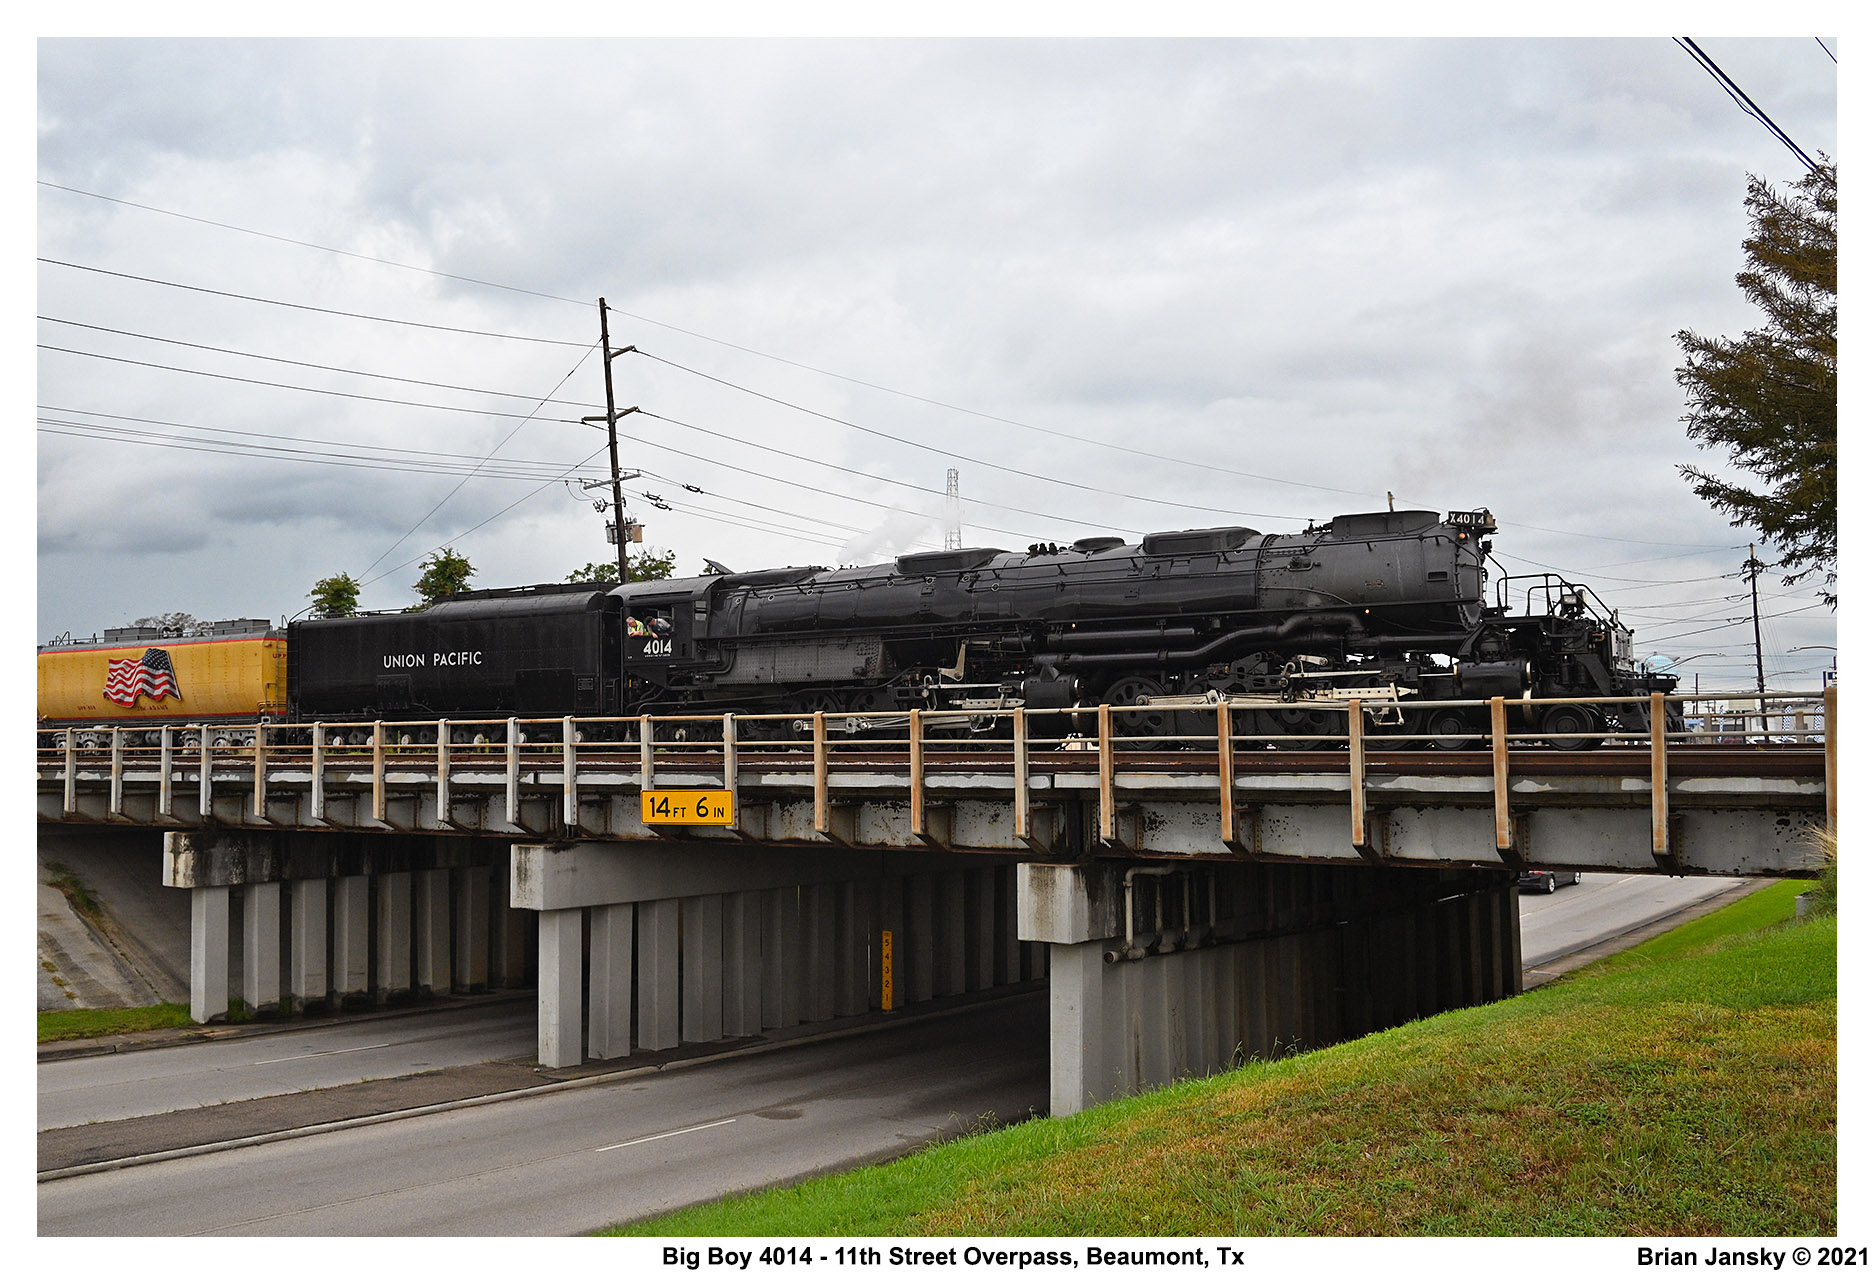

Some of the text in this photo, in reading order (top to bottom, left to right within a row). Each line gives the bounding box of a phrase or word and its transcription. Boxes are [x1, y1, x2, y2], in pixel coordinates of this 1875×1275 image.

[1450, 513, 1485, 524] X4014
[643, 639, 672, 654] 4014
[383, 651, 482, 669] UNION PACIFIC
[649, 796, 725, 818] 14 FT 6 IN
